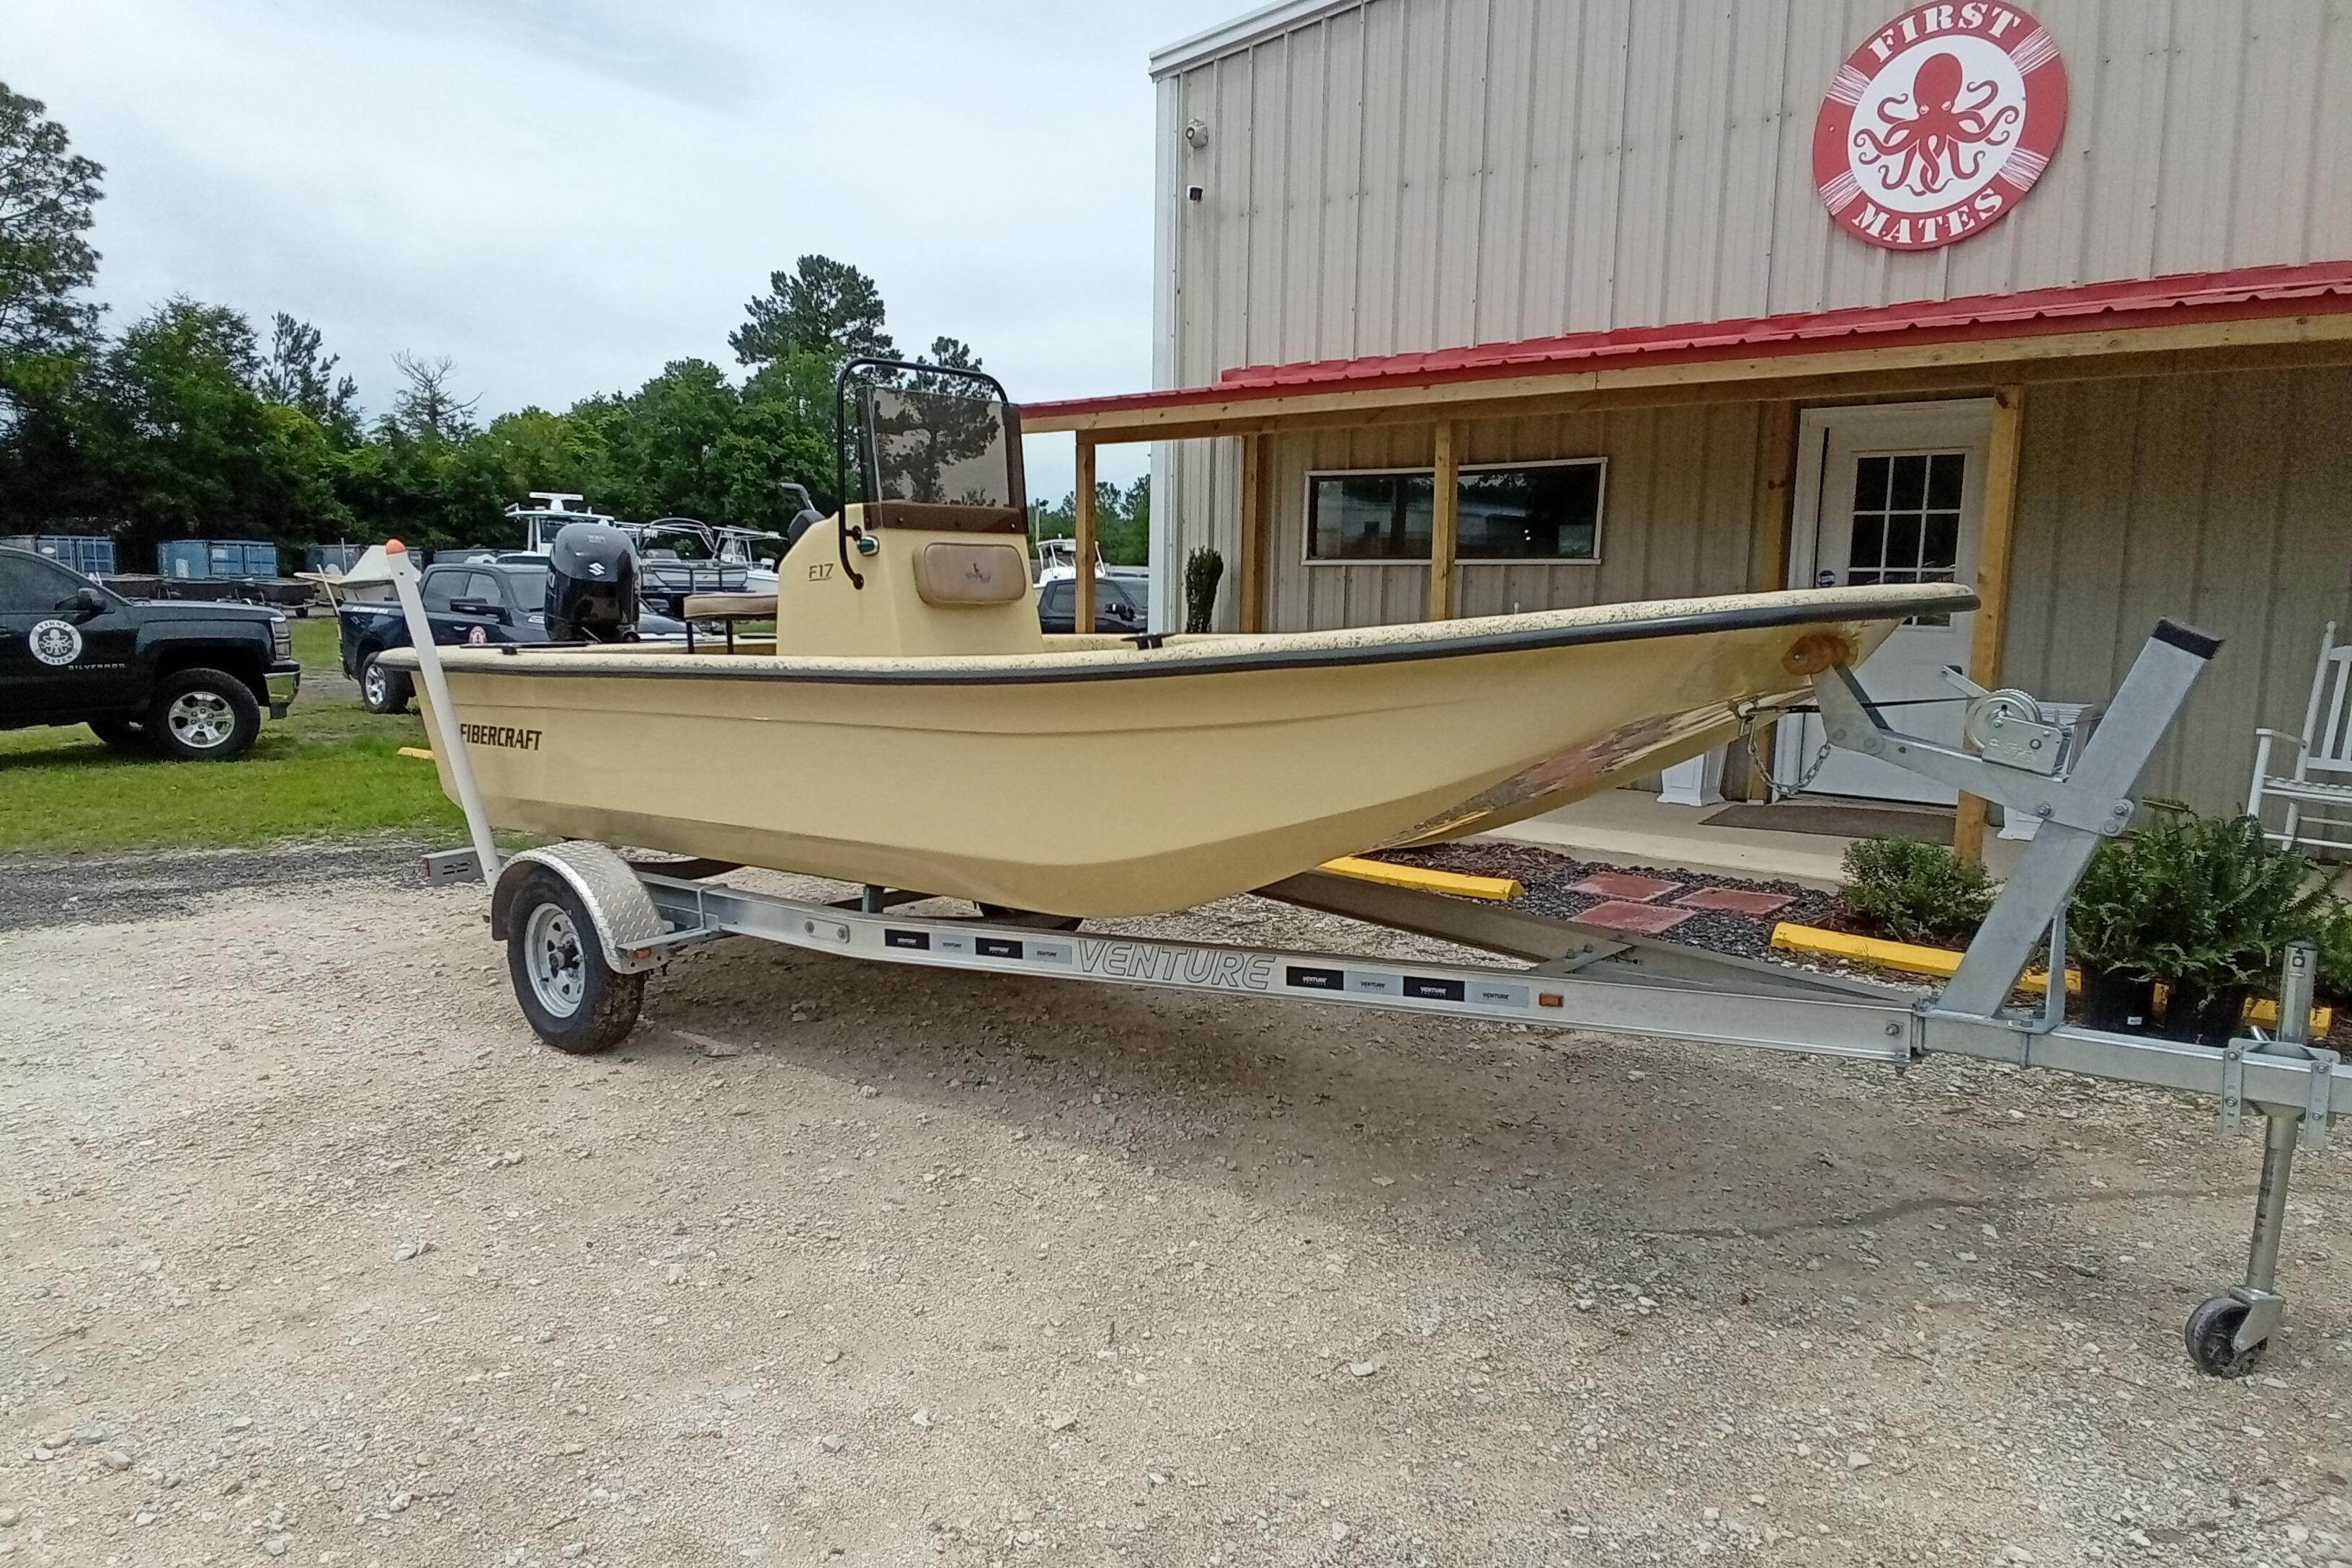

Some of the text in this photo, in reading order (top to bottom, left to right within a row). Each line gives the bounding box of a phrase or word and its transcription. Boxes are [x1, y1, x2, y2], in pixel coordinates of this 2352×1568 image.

[1868, 1, 2021, 63] FIRST
[1851, 188, 2003, 244] MATES
[808, 563, 834, 579] F17
[460, 723, 543, 751] FIBERCRAFT
[1078, 939, 1276, 989] VENTURE
